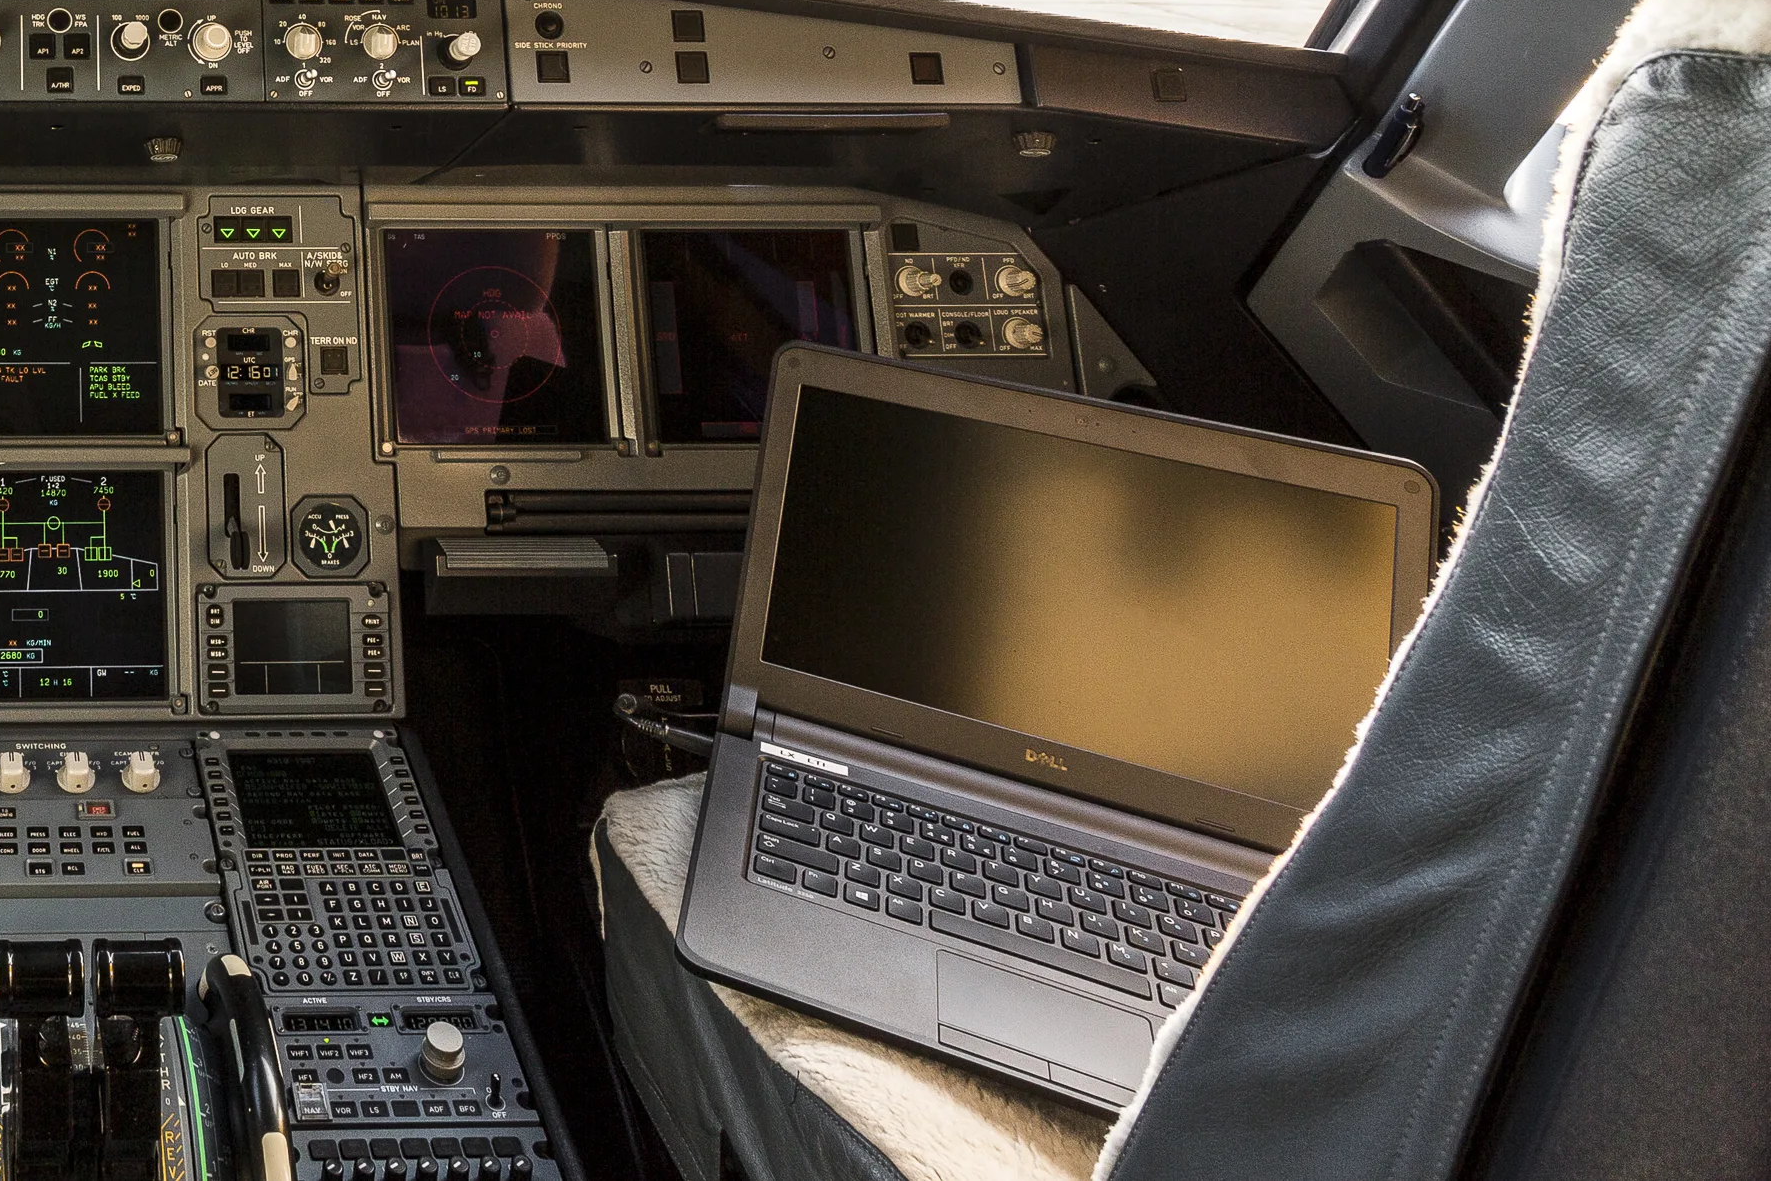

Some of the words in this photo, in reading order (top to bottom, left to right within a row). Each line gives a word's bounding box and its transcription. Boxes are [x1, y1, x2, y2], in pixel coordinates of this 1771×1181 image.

[41, 489, 66, 497] 14870
[780, 750, 795, 758] LX
[807, 758, 826, 767] LTI
[1025, 749, 1068, 771] DELL
